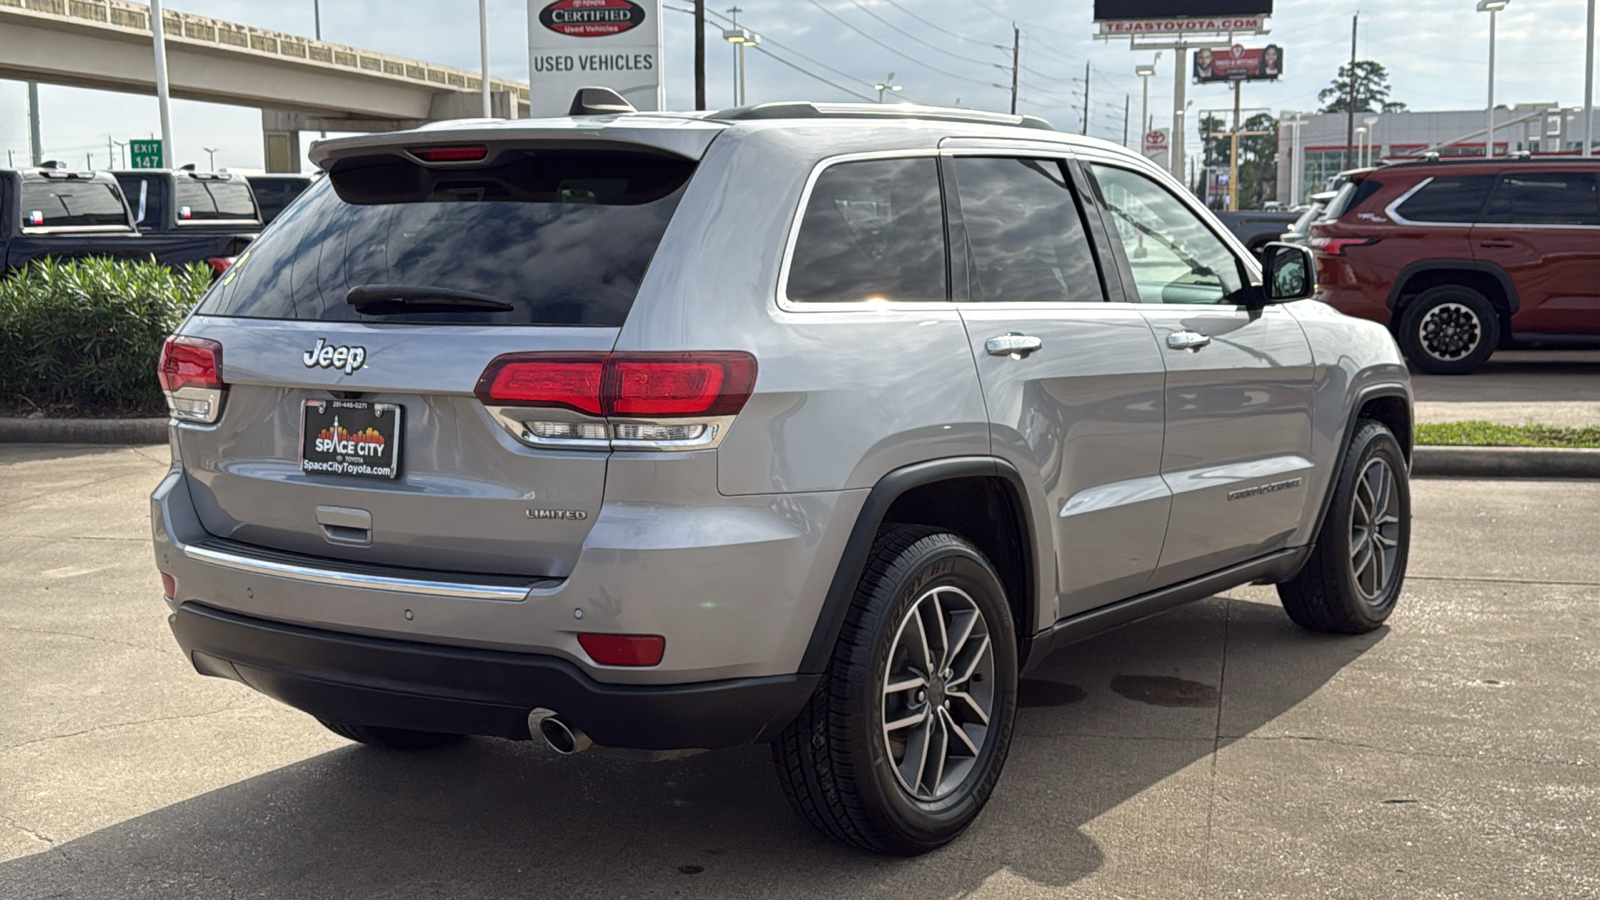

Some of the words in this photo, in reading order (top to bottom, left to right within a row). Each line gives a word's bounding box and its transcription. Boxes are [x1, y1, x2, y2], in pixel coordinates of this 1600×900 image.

[551, 9, 631, 23] CERTIFIED
[564, 25, 583, 34] Used
[586, 25, 618, 33] Vehicles
[1106, 19, 1258, 31] TEJASTOYOTA.COM
[534, 56, 574, 72] USED
[579, 54, 653, 71] VEHICLES
[134, 144, 158, 153] EXIT
[136, 156, 159, 168] 147
[303, 338, 366, 375] Jeep
[332, 401, 368, 409] 281-446-0271
[315, 430, 355, 454] SPACE
[357, 442, 384, 457] CITY
[304, 460, 391, 476] SpaceCityToyota.com
[526, 508, 587, 520] LIMITED
